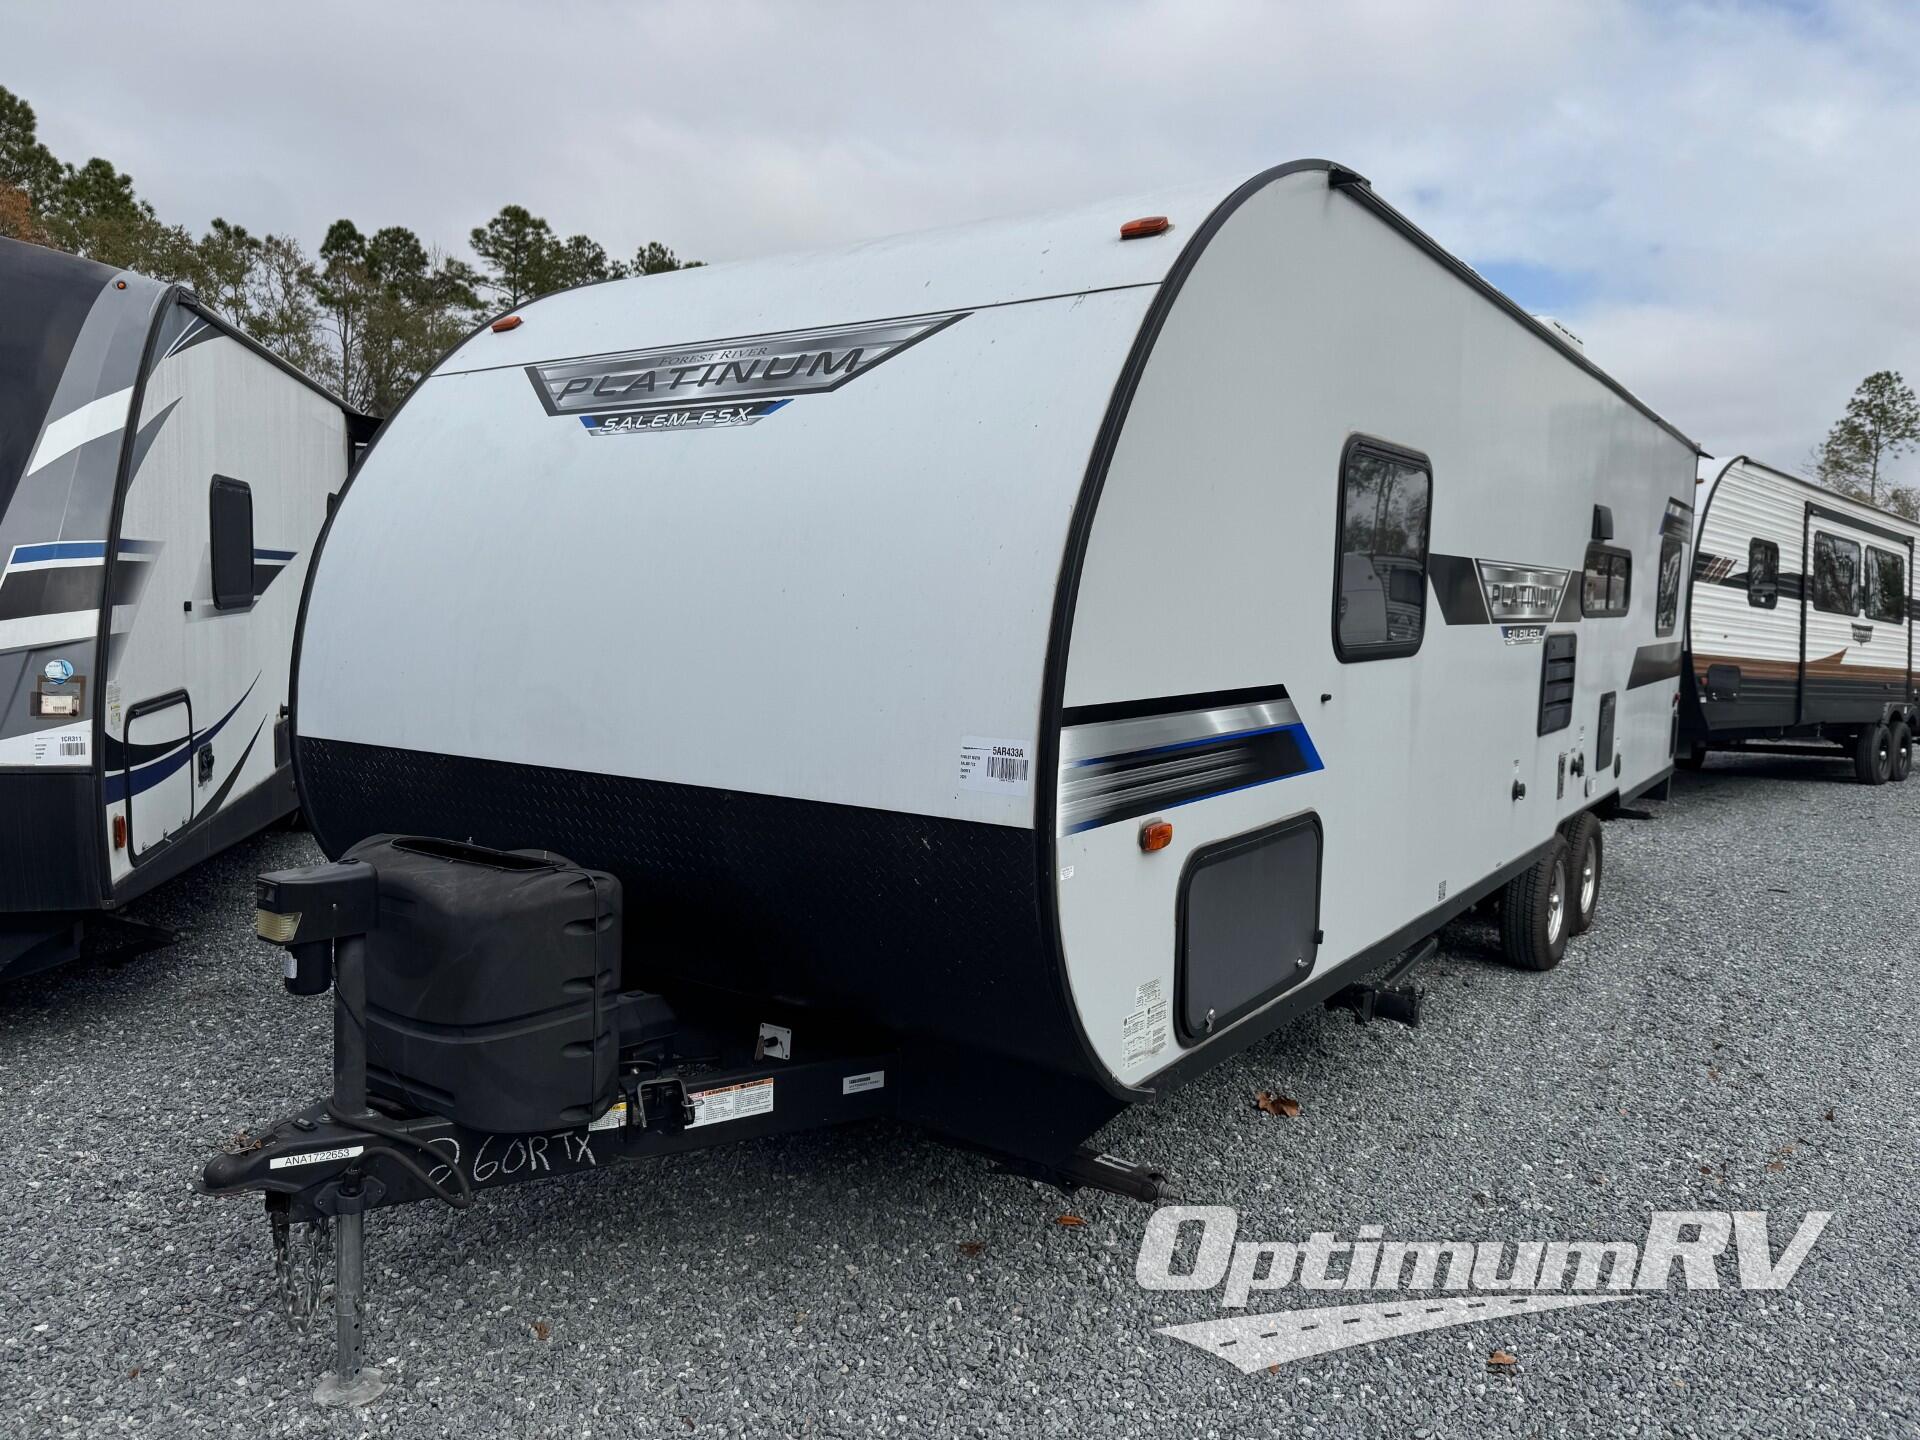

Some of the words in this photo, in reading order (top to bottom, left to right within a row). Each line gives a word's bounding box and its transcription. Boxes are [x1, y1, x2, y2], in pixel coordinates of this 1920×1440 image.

[658, 352, 716, 367] FOREST
[720, 347, 768, 360] RIVER
[556, 347, 865, 401] PLATINUM
[600, 412, 692, 432] SALEM
[697, 406, 754, 424] FSX
[1491, 584, 1558, 609] PLATINUM
[284, 1148, 350, 1167] ANA1722653
